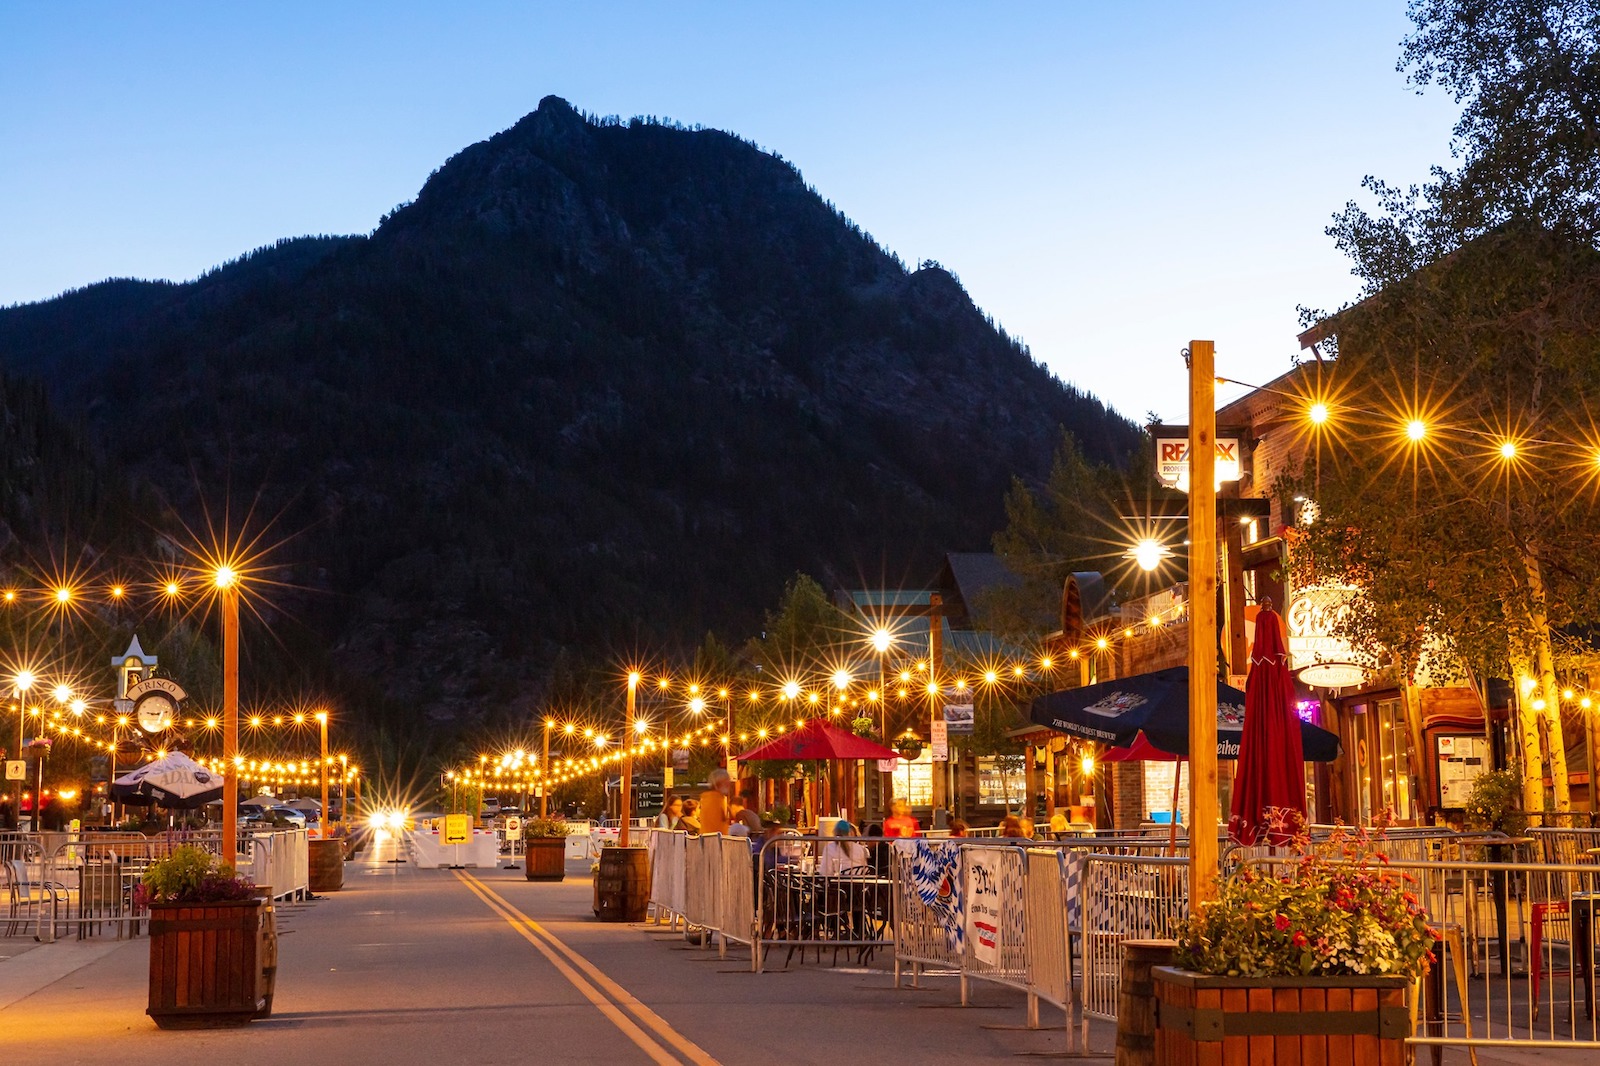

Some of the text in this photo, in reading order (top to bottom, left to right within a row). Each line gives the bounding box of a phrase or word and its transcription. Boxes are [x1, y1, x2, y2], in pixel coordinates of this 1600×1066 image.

[137, 680, 177, 693] FRISCO
[1052, 718, 1063, 728] THE
[1080, 725, 1097, 736] OLDEST
[1096, 730, 1117, 741] BREWERY
